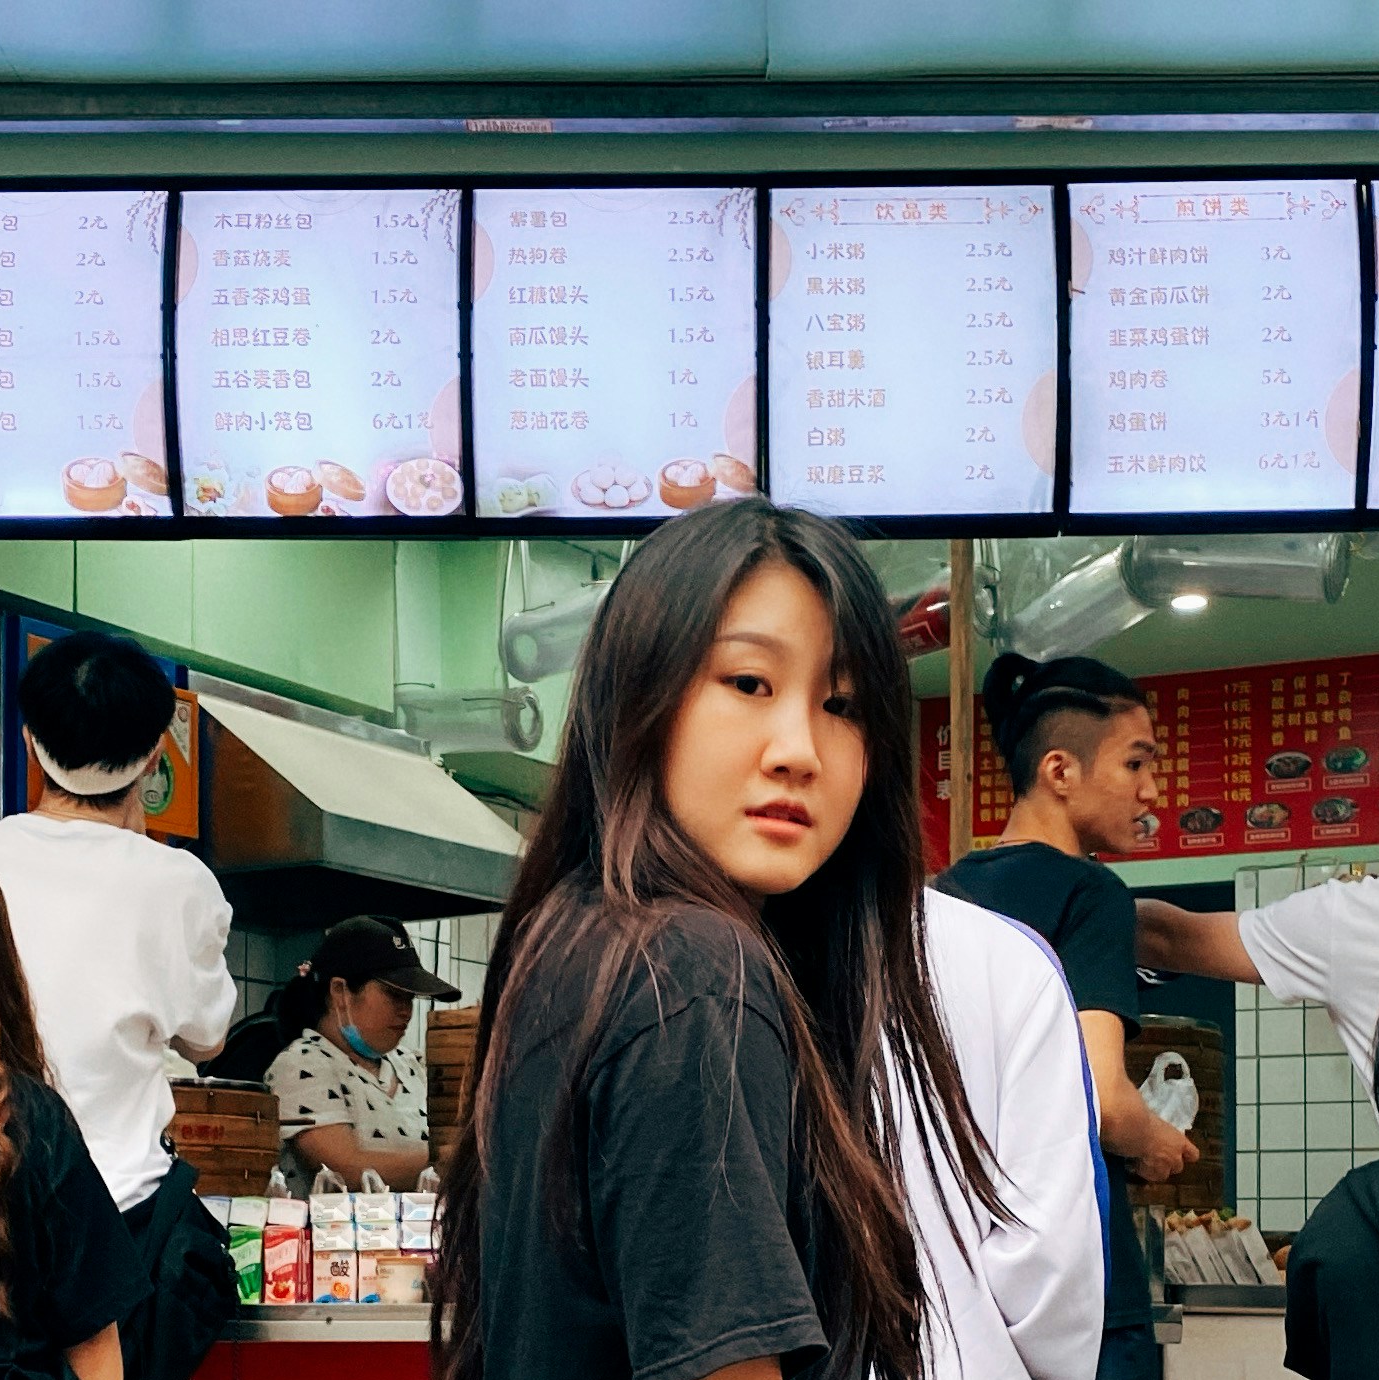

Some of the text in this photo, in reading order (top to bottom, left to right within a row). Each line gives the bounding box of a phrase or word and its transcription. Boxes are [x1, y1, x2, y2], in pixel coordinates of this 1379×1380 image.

[667, 209, 716, 226] 2.5元
[874, 201, 949, 222] 饮品类
[1175, 196, 1250, 218] 煎饼类
[77, 215, 109, 231] 2元
[213, 211, 420, 231] 木耳粉丝包 1.5元
[75, 251, 107, 268] 2元
[212, 248, 419, 268] 香菇烧麦 1.5元
[507, 246, 716, 266] 热狗卷 2.5元
[805, 241, 1014, 261] 小米粥 2.5元
[1107, 245, 1292, 267] 鸡汁鲜肉饼 3元
[370, 288, 419, 305] 1.5元
[508, 284, 716, 306] 红糖馒头 1.5元
[806, 276, 1014, 297] 黑米粥 2.5元
[1107, 284, 1293, 307] 黄金南瓜饼 2元
[74, 289, 105, 306] 2元
[805, 311, 1014, 333] 八宝粥 2.5元
[74, 329, 122, 347] 1.5元
[210, 326, 402, 348] 相思红豆卷 2元
[508, 324, 716, 347] 南瓜馒头 1.5元
[1261, 325, 1293, 343] 2元
[965, 348, 1014, 367] 2.5元
[75, 371, 122, 389] 1.5元
[211, 368, 403, 390] 五谷麦香包 2元
[508, 367, 699, 389] 老面馒头 1元
[1108, 367, 1293, 391] 鸡肉卷 5元
[805, 386, 1014, 410] 香甜米酒 2.5元
[77, 413, 124, 431] 1.5元
[214, 410, 314, 432] 鲜肉小笼包
[509, 409, 699, 431] 葱油花卷 1元
[1107, 408, 1319, 433] 鸡蛋饼 3元1片
[806, 425, 997, 448] 白粥 2元
[806, 464, 996, 485] 现磨豆浆 2元
[1106, 453, 1207, 475] 玉米鲜肉饺
